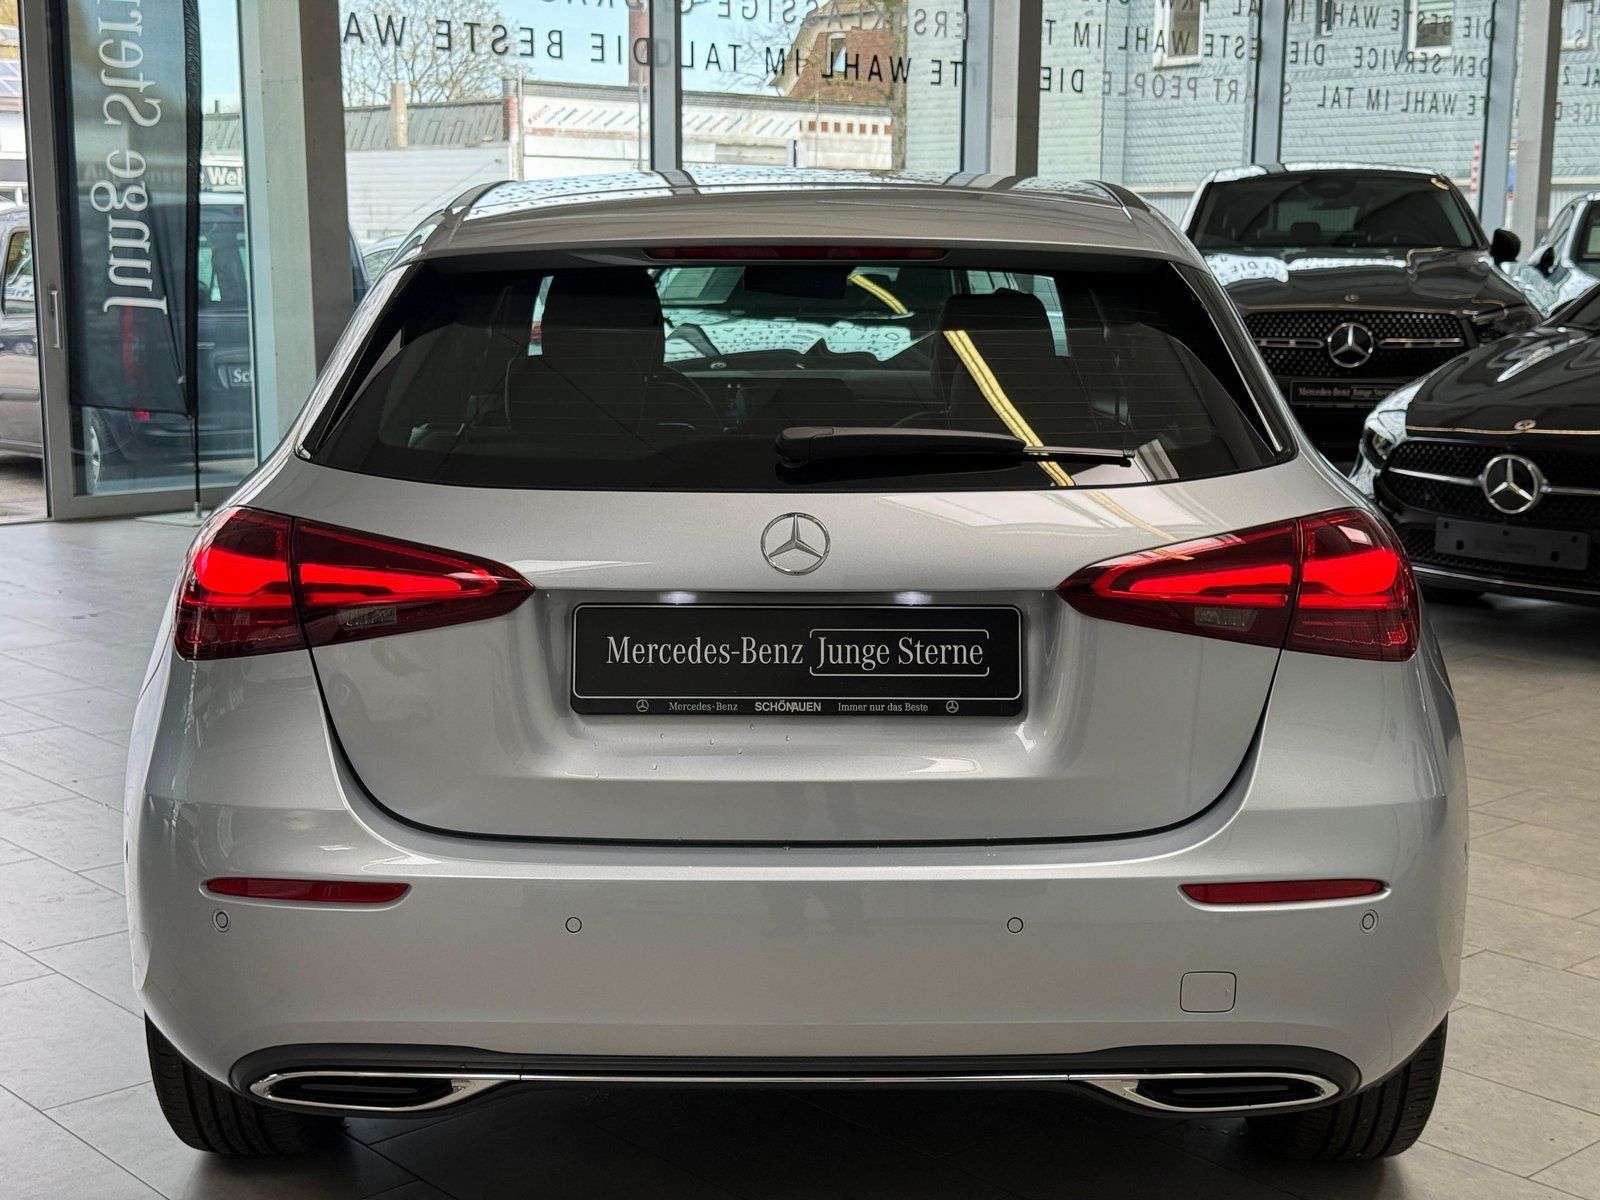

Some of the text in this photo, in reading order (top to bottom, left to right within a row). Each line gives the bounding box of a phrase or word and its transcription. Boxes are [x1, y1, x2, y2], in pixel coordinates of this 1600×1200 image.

[606, 636, 984, 671] Mercedes-Benz Junge Sterne
[669, 701, 738, 712] Mercedes-Benz
[838, 702, 867, 712] Immer
[869, 703, 886, 712] nur
[887, 702, 903, 712] das
[904, 702, 929, 712] Beste
